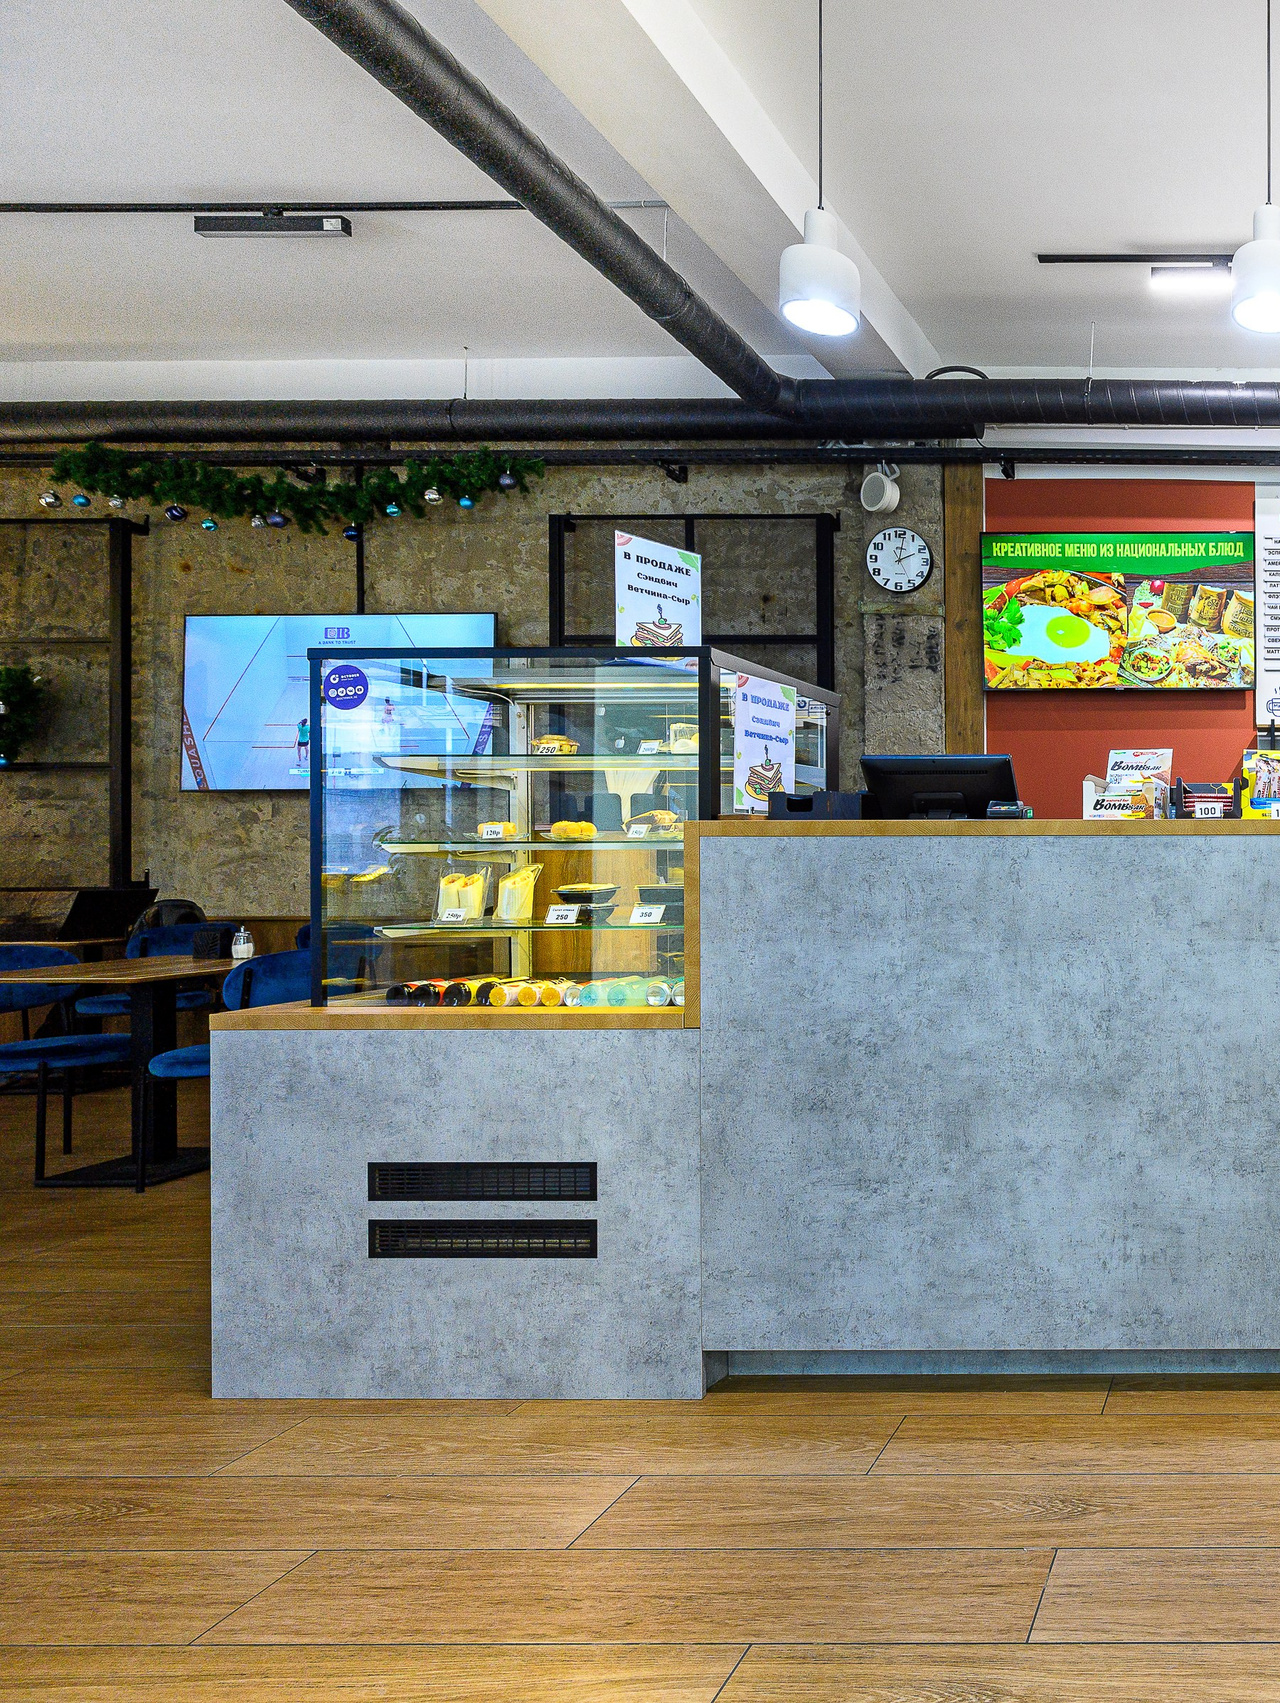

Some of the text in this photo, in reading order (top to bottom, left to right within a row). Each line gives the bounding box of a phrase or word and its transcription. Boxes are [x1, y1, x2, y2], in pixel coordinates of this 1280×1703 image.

[882, 532, 891, 541] 11
[894, 530, 906, 539] 12
[911, 534, 915, 542] 1
[873, 542, 883, 550] 10
[918, 545, 926, 553] 2
[992, 541, 1244, 559] КРЕАТИВНОЕ МЕНЮ ИЗ НАЦИОНАЛЬНЫХ БЛЮД
[869, 554, 878, 563] 9
[921, 557, 929, 566] 3
[623, 551, 691, 577] В ПРОДАЖЕ
[872, 568, 881, 576] 8
[916, 571, 925, 579] 4
[882, 578, 890, 586] 7
[894, 582, 902, 590] 6
[907, 579, 916, 588] 5
[741, 692, 790, 712] В ПРОДАЖЕ
[539, 746, 556, 754] 250
[1093, 798, 1145, 811] BOMBBAR
[1199, 807, 1216, 816] 100
